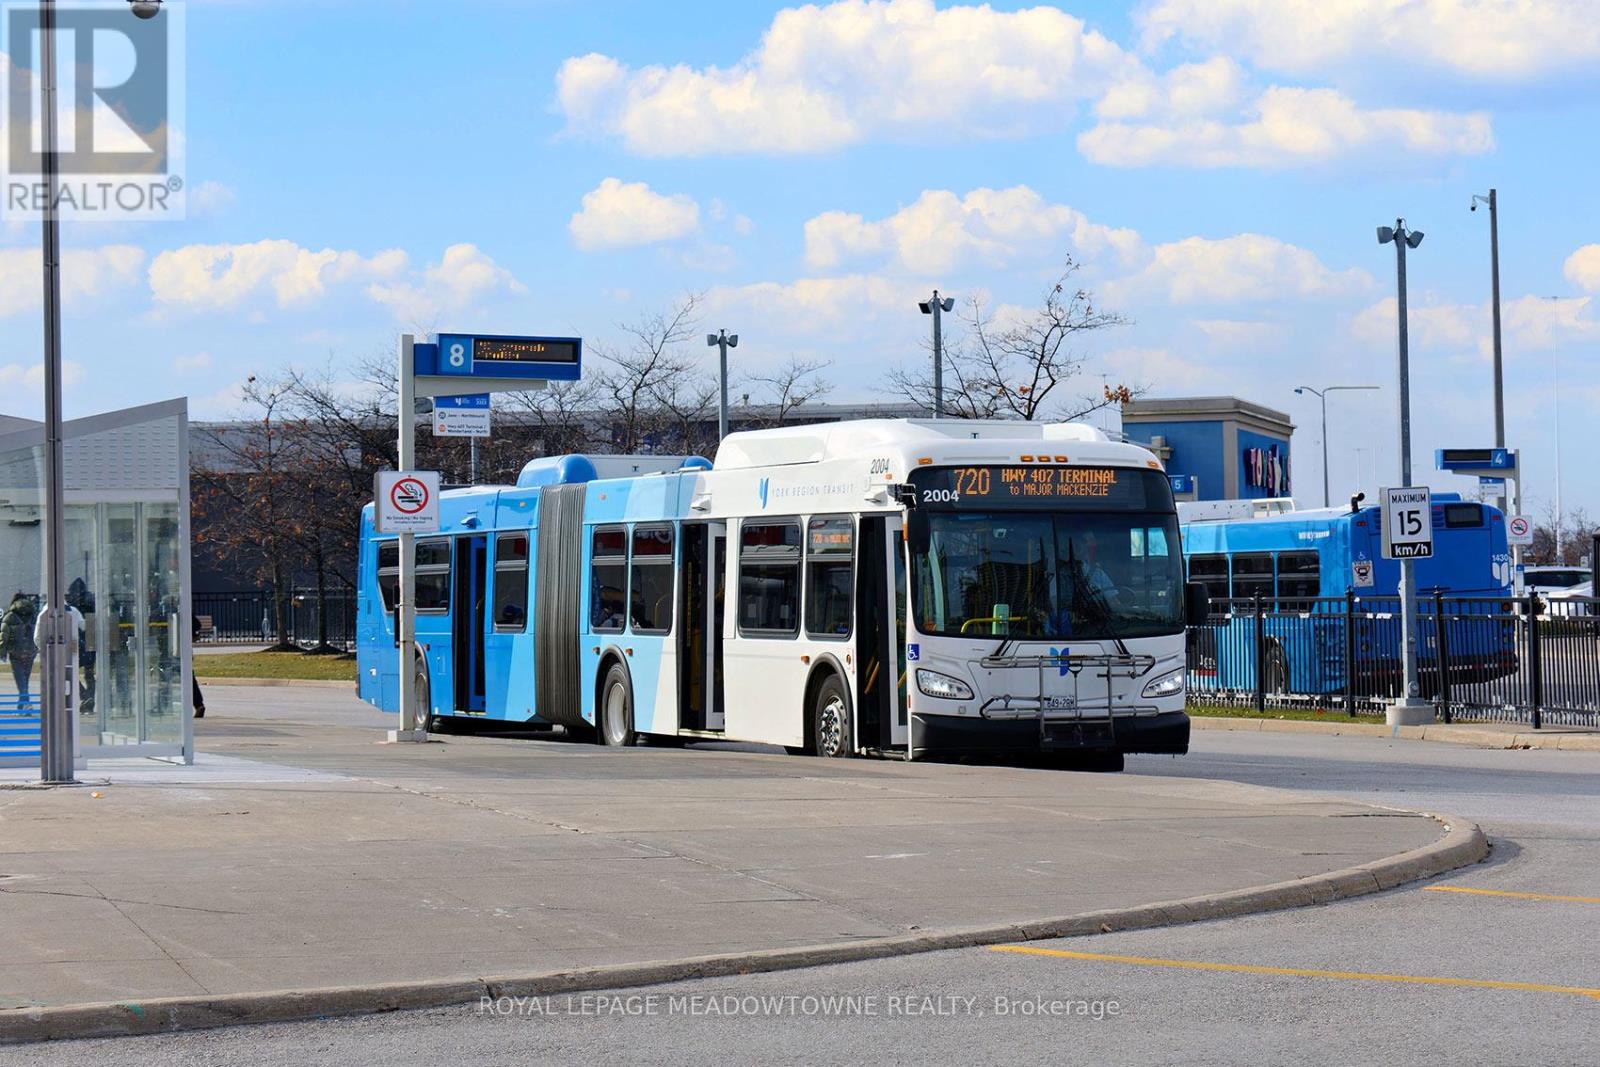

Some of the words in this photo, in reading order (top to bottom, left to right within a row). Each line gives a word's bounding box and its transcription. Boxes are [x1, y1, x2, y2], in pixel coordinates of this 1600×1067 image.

[449, 343, 465, 367] 8
[1495, 452, 1503, 465] 4
[870, 458, 890, 474] 2004
[953, 468, 990, 495] 720
[1001, 469, 1026, 484] HWY
[1030, 469, 1055, 484] 407
[1058, 469, 1117, 484] TERMINAL
[792, 485, 820, 497] REGION
[823, 482, 854, 495] TRANSIT
[1009, 484, 1020, 496] to
[1023, 484, 1053, 496] MAJOR
[1057, 484, 1108, 497] MACKENZIE
[1174, 479, 1182, 490] 5
[922, 489, 960, 503] 2004
[1391, 493, 1427, 504] MAXIMUM
[1398, 510, 1422, 536] 15
[1395, 543, 1428, 556] km/h
[1492, 553, 1509, 562] 1430
